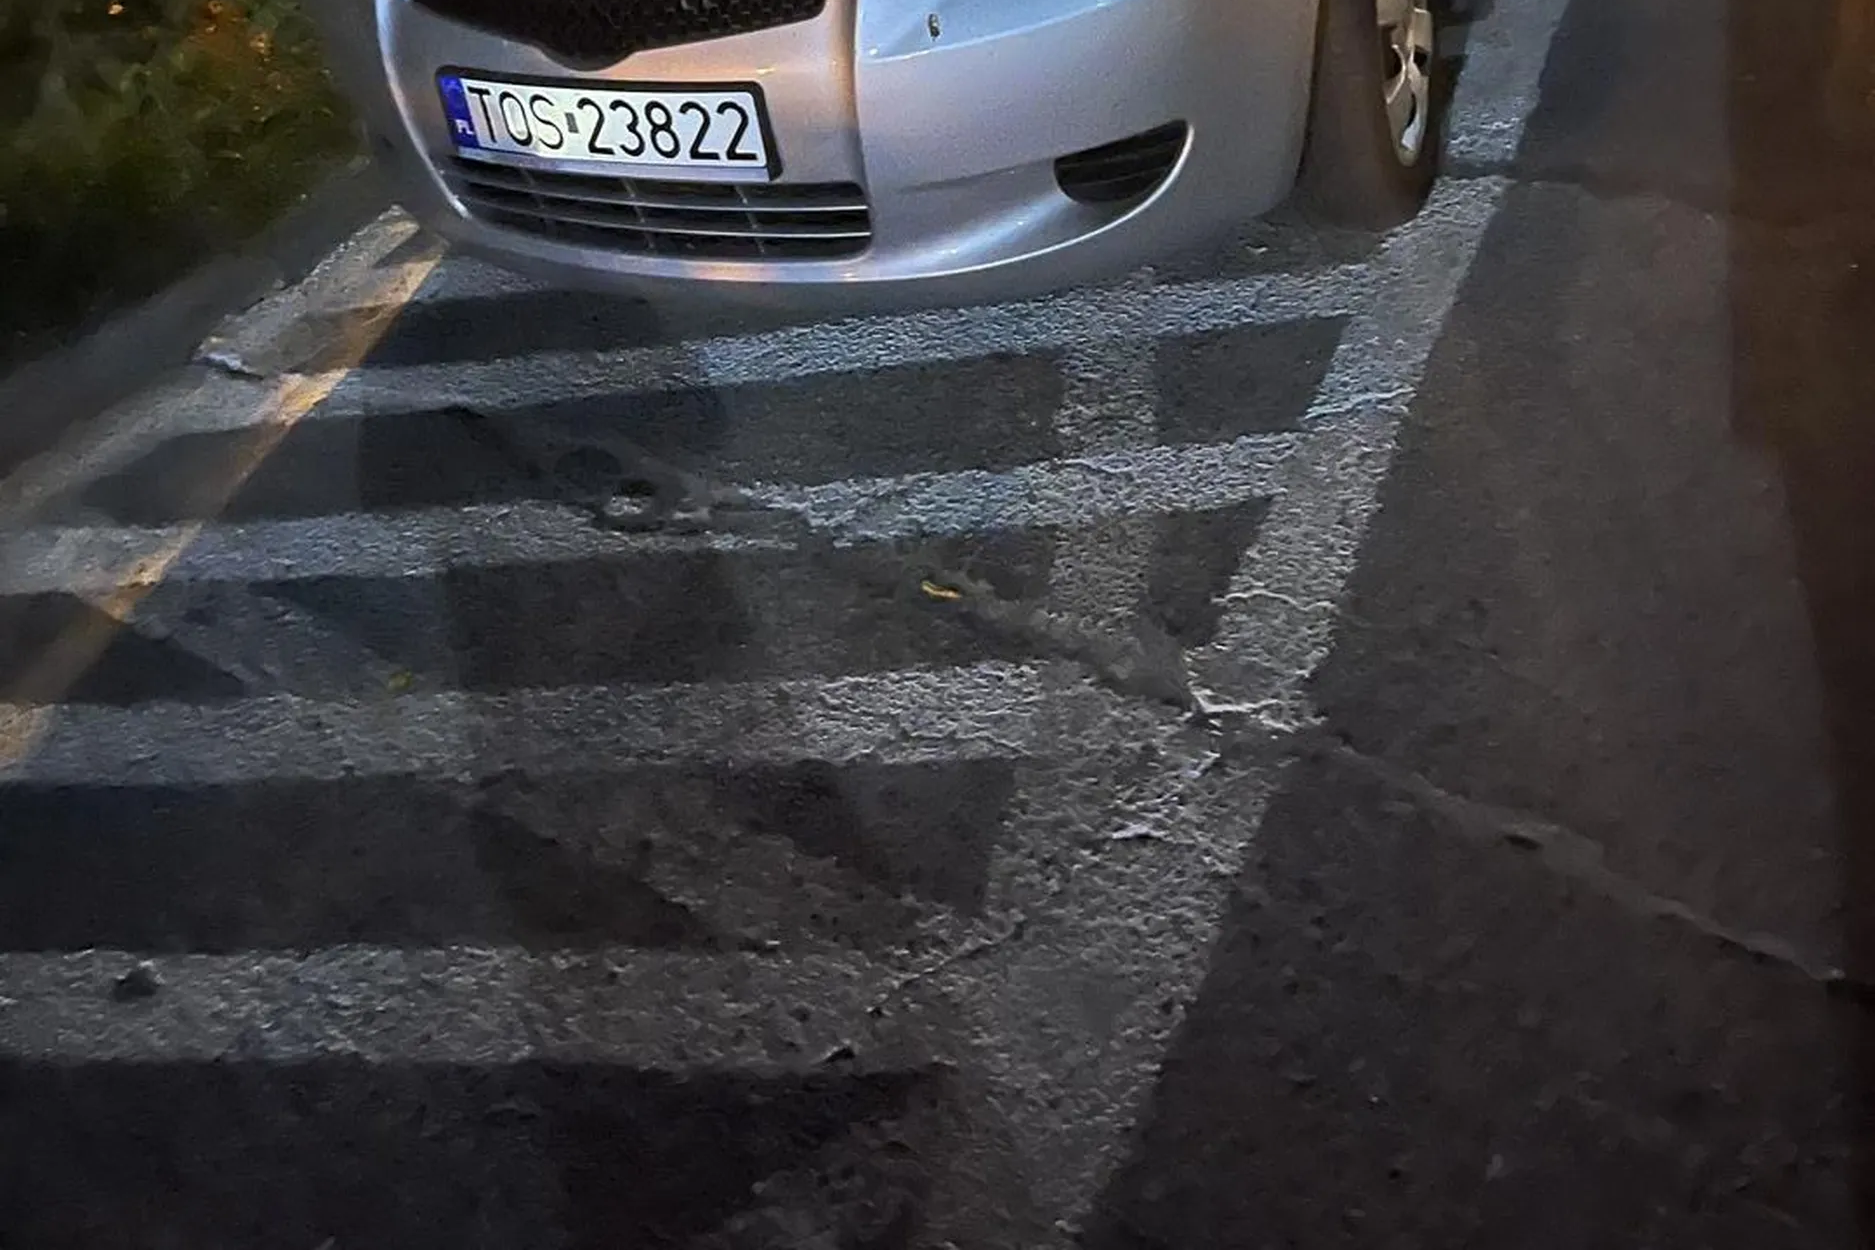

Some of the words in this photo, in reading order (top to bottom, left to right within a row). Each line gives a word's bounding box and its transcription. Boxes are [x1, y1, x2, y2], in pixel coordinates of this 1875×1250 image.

[455, 118, 474, 135] PL
[466, 86, 564, 150] TOS
[576, 97, 759, 161] 23822
